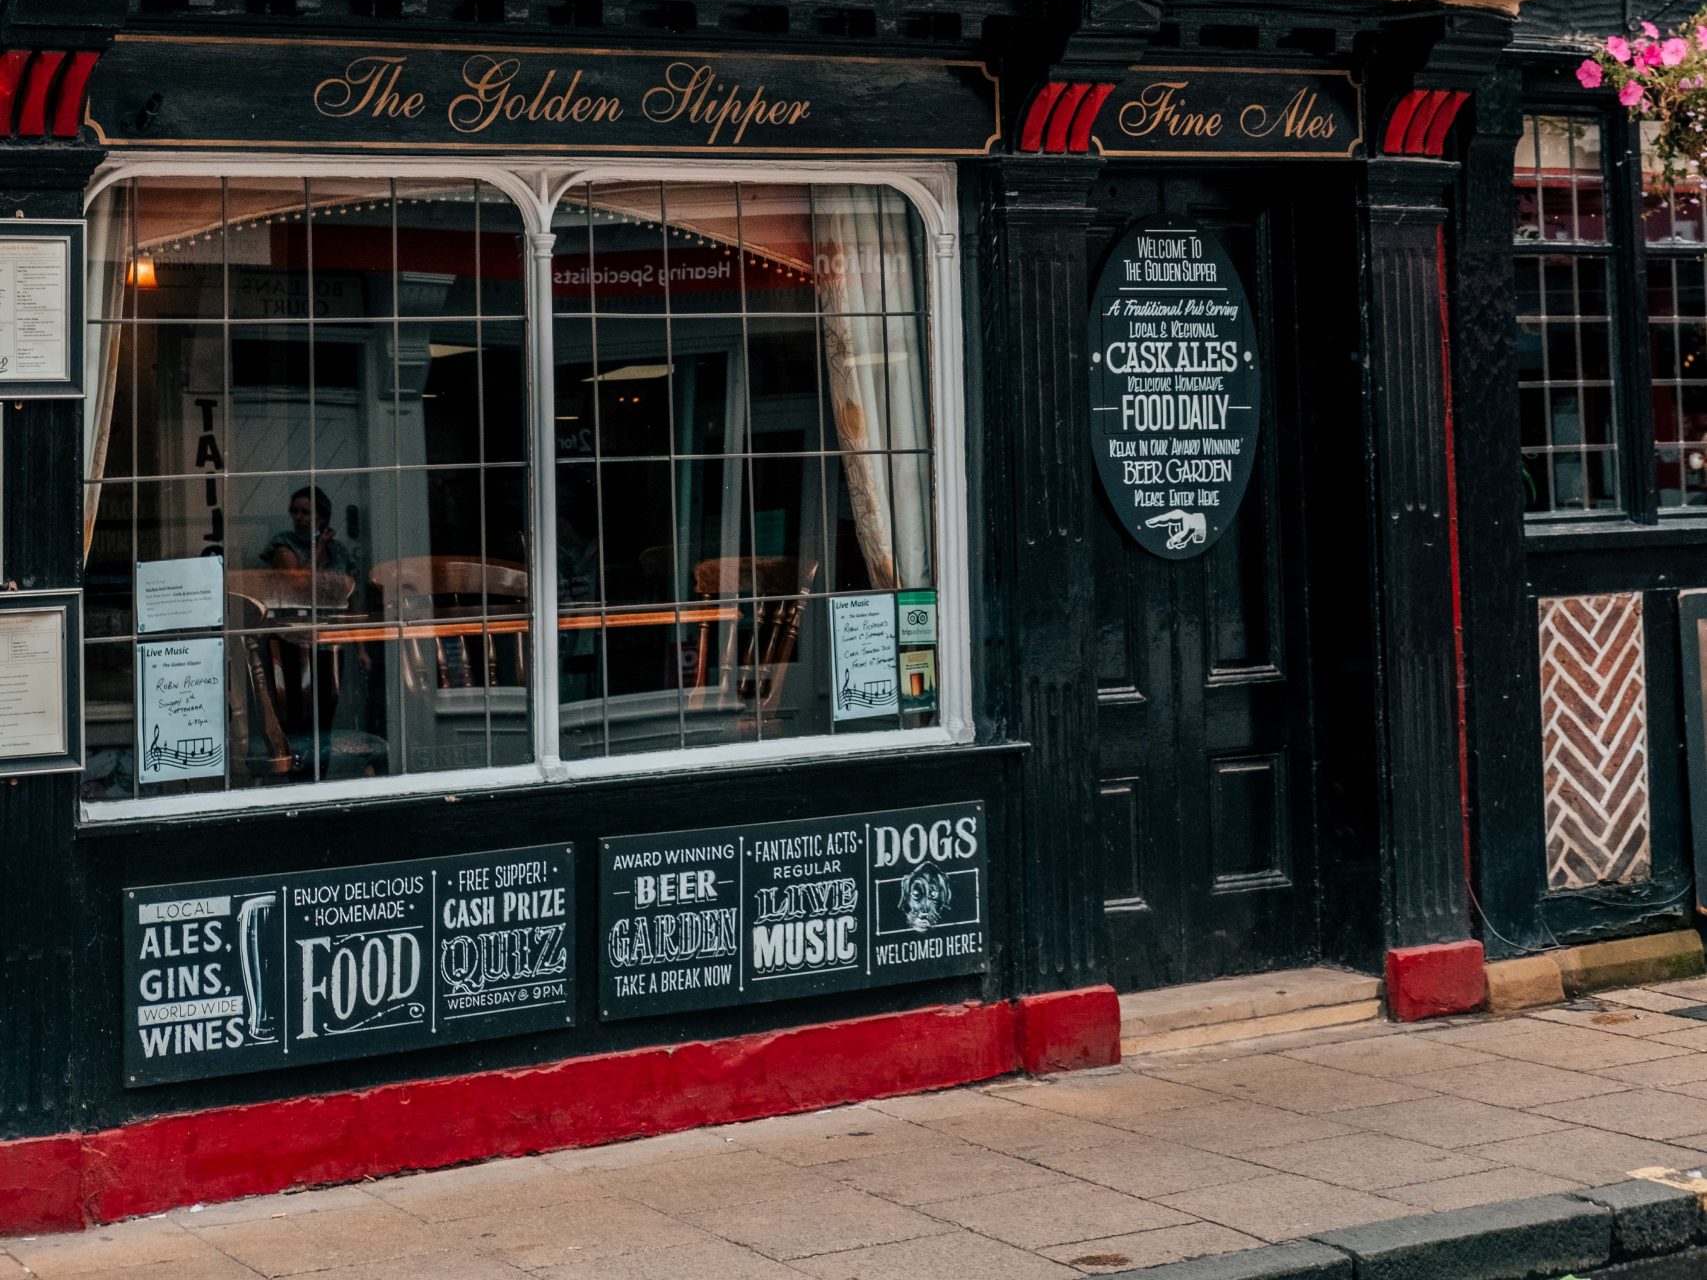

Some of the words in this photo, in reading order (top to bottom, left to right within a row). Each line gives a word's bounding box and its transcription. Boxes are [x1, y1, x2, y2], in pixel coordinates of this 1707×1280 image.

[314, 56, 424, 118] The
[448, 55, 624, 134] Golden
[642, 62, 811, 145] Slipper
[1119, 81, 1224, 137] Fine
[1240, 86, 1338, 139] Ales
[1137, 236, 1187, 259] WELCOME
[1189, 236, 1202, 259] TO
[1124, 259, 1142, 282] THE
[1145, 259, 1181, 282] GOLDEN
[1183, 260, 1217, 282] SLIPPER
[1102, 299, 1121, 316] A
[1123, 299, 1183, 316] Traditional
[1184, 299, 1204, 316] Pub
[1205, 300, 1239, 321] Serving
[1129, 321, 1159, 339] LOCAL
[1160, 322, 1168, 339] &
[1171, 320, 1218, 338] REGIONAL
[1106, 341, 1172, 374] CASK
[1174, 341, 1238, 373] ALES
[1127, 376, 1172, 393] DELICIOUS
[1174, 375, 1224, 392] HOMEMADE
[1122, 394, 1175, 431] FOOD
[1178, 394, 1230, 430] DAILY
[1109, 439, 1137, 458] RELAX
[1139, 439, 1149, 456] IN
[1150, 438, 1168, 456] OUR
[1122, 460, 1165, 485] BEER
[1165, 458, 1233, 484] GARDEN
[1134, 489, 1166, 507] PLEASE
[1169, 489, 1195, 507] ENTER
[1197, 489, 1220, 507] HERE
[836, 602, 849, 610] Live
[850, 598, 870, 608] Music
[146, 647, 163, 658] Live
[164, 645, 189, 656] Music
[613, 851, 662, 871] AWARD
[665, 844, 735, 864] WINNING
[755, 835, 823, 862] FANTASTIC
[826, 830, 858, 856] ACTS
[874, 816, 978, 868] DOGS
[458, 867, 490, 893] FREE
[495, 861, 548, 888] SUPPER!
[773, 859, 841, 880] REGULAR
[294, 885, 340, 906] ENJOY
[345, 876, 424, 900] DELICIOUS
[634, 869, 718, 910] BEER
[753, 878, 858, 925] LIVE
[156, 901, 215, 920] LOCAL
[315, 900, 405, 927] HOMEMADE
[443, 896, 495, 929] CASH
[503, 888, 566, 923] PRIZE
[139, 920, 232, 960] ALES,
[607, 907, 738, 968] GARDEN
[752, 915, 857, 974] MUSIC
[875, 937, 944, 966] WELCOMED
[945, 931, 983, 957] HERE!
[440, 922, 567, 995] QUIZ
[139, 962, 231, 1002] GINS,
[295, 932, 421, 1040] FOOD
[614, 971, 646, 998] TAKE
[649, 971, 658, 993] A
[661, 967, 701, 992] BREAK
[703, 963, 732, 989] NOW
[143, 1004, 197, 1022] WORLD
[201, 999, 238, 1016] WIDE
[447, 992, 517, 1010] WEDNESDAY
[518, 988, 529, 1001] @
[138, 1017, 244, 1059] WINES
